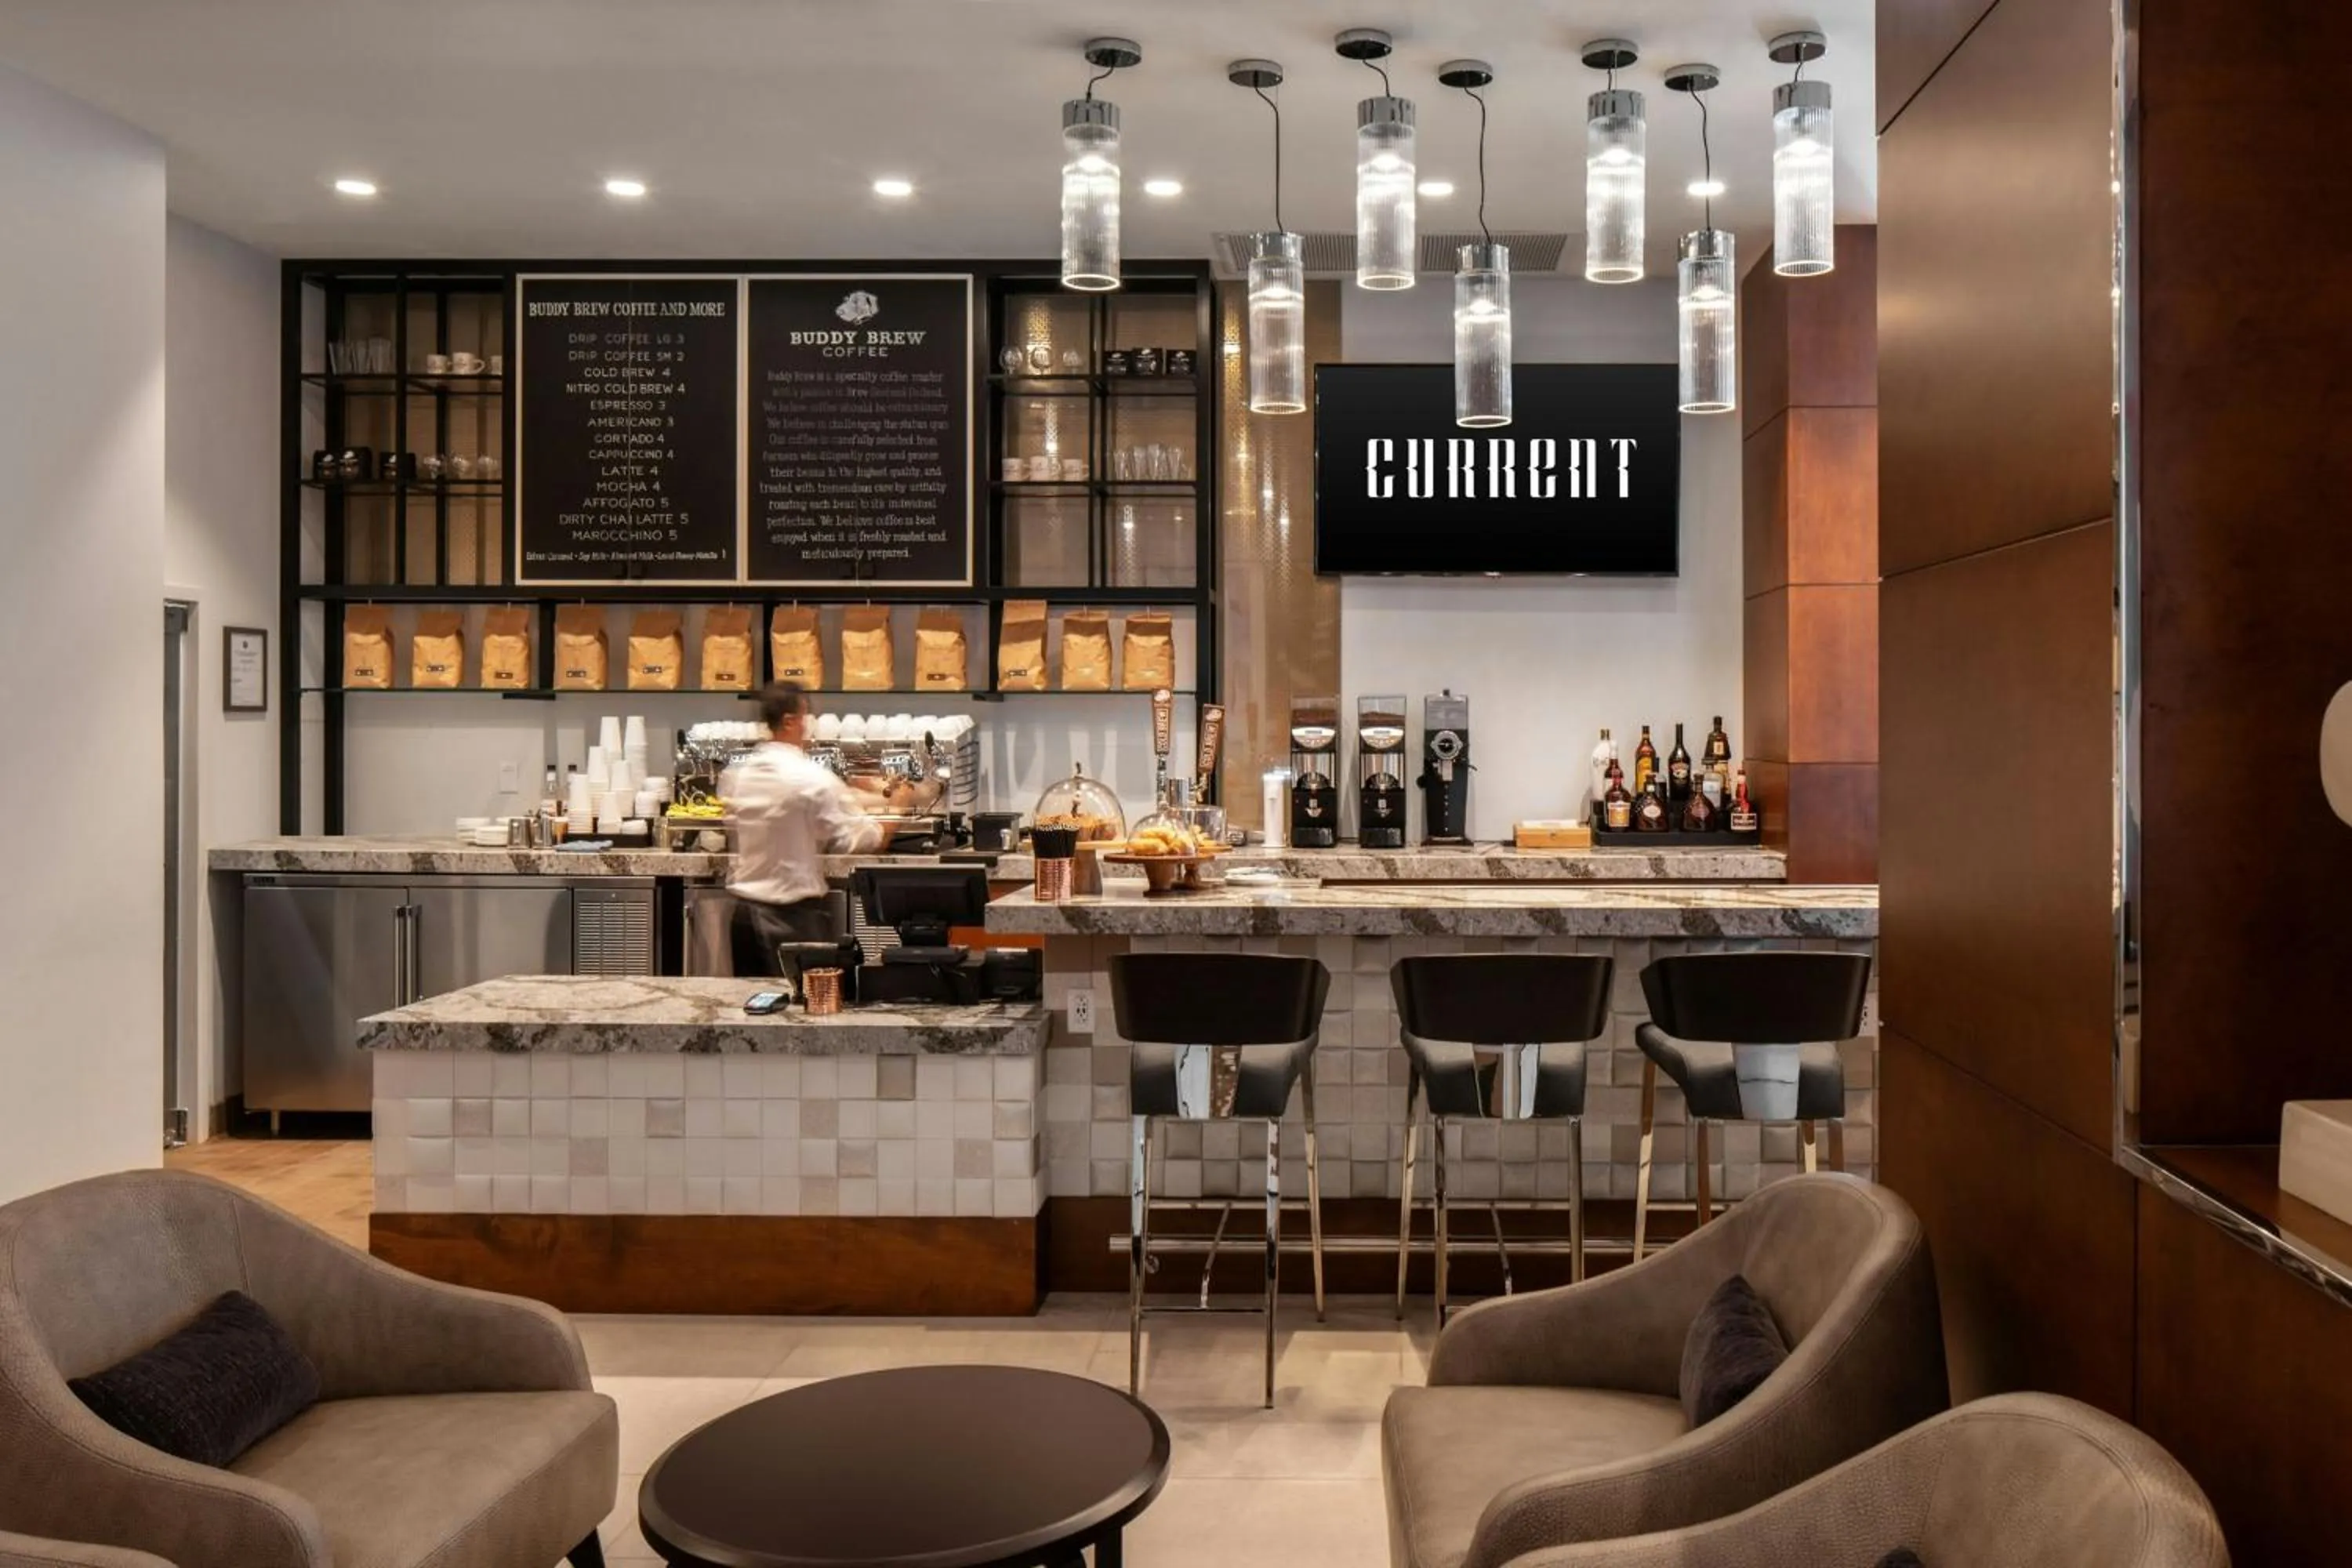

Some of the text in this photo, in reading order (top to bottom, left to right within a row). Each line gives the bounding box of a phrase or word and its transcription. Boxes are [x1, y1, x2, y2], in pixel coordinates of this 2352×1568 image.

[528, 302, 570, 317] BUDDY
[574, 302, 611, 317] BREW
[660, 302, 688, 317] AND
[689, 302, 725, 317] MORE
[568, 333, 597, 344] DRIP
[604, 333, 651, 344] COFFEE
[789, 331, 927, 345] BUDDY BREW
[568, 351, 597, 362] DRIP
[604, 351, 651, 362] COFFEE
[822, 347, 889, 358] COFFEE
[584, 368, 671, 378] COLD BREW 4
[566, 383, 686, 394] NITRO COLD BREW 4
[590, 401, 653, 411] ESPRESSO
[587, 417, 662, 427] AMERICANO
[594, 434, 665, 444] CORTADO 4
[588, 450, 674, 459] CAPPUCCINO 4
[601, 466, 659, 476] LATTE 4
[596, 482, 661, 492] MOCHA 4
[583, 498, 669, 508] AFFOGATO 5
[559, 514, 689, 524] DIRTY CHAI LATTE 5
[572, 530, 677, 541] MAROCCHINO 5
